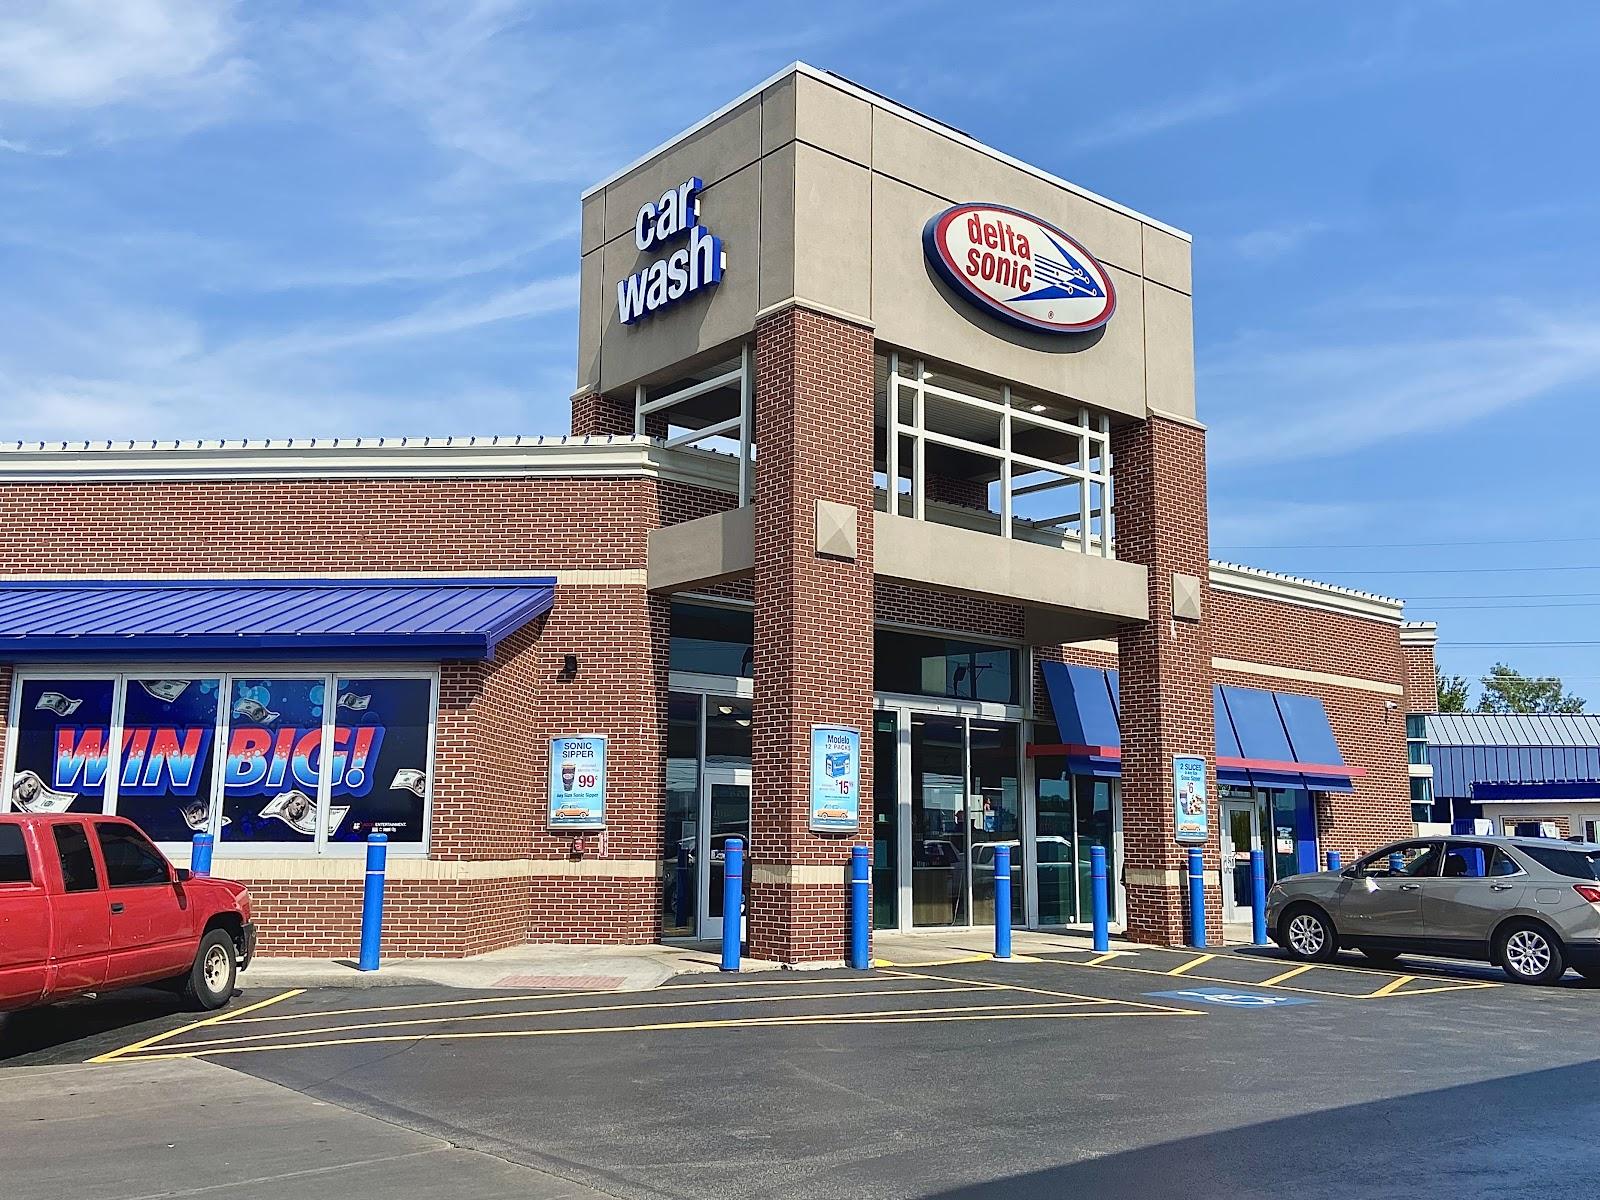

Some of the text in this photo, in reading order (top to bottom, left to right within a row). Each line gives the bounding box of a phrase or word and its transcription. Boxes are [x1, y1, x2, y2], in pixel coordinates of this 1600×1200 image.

[635, 177, 702, 252] car
[967, 212, 1032, 260] delta
[616, 224, 722, 325] wash
[965, 248, 1032, 293] sonic
[54, 725, 377, 788] WIN BIG!
[562, 750, 594, 758] SIPPER
[564, 742, 592, 750] SONIC
[827, 734, 850, 745] Modelo
[1185, 763, 1202, 771] SLICES
